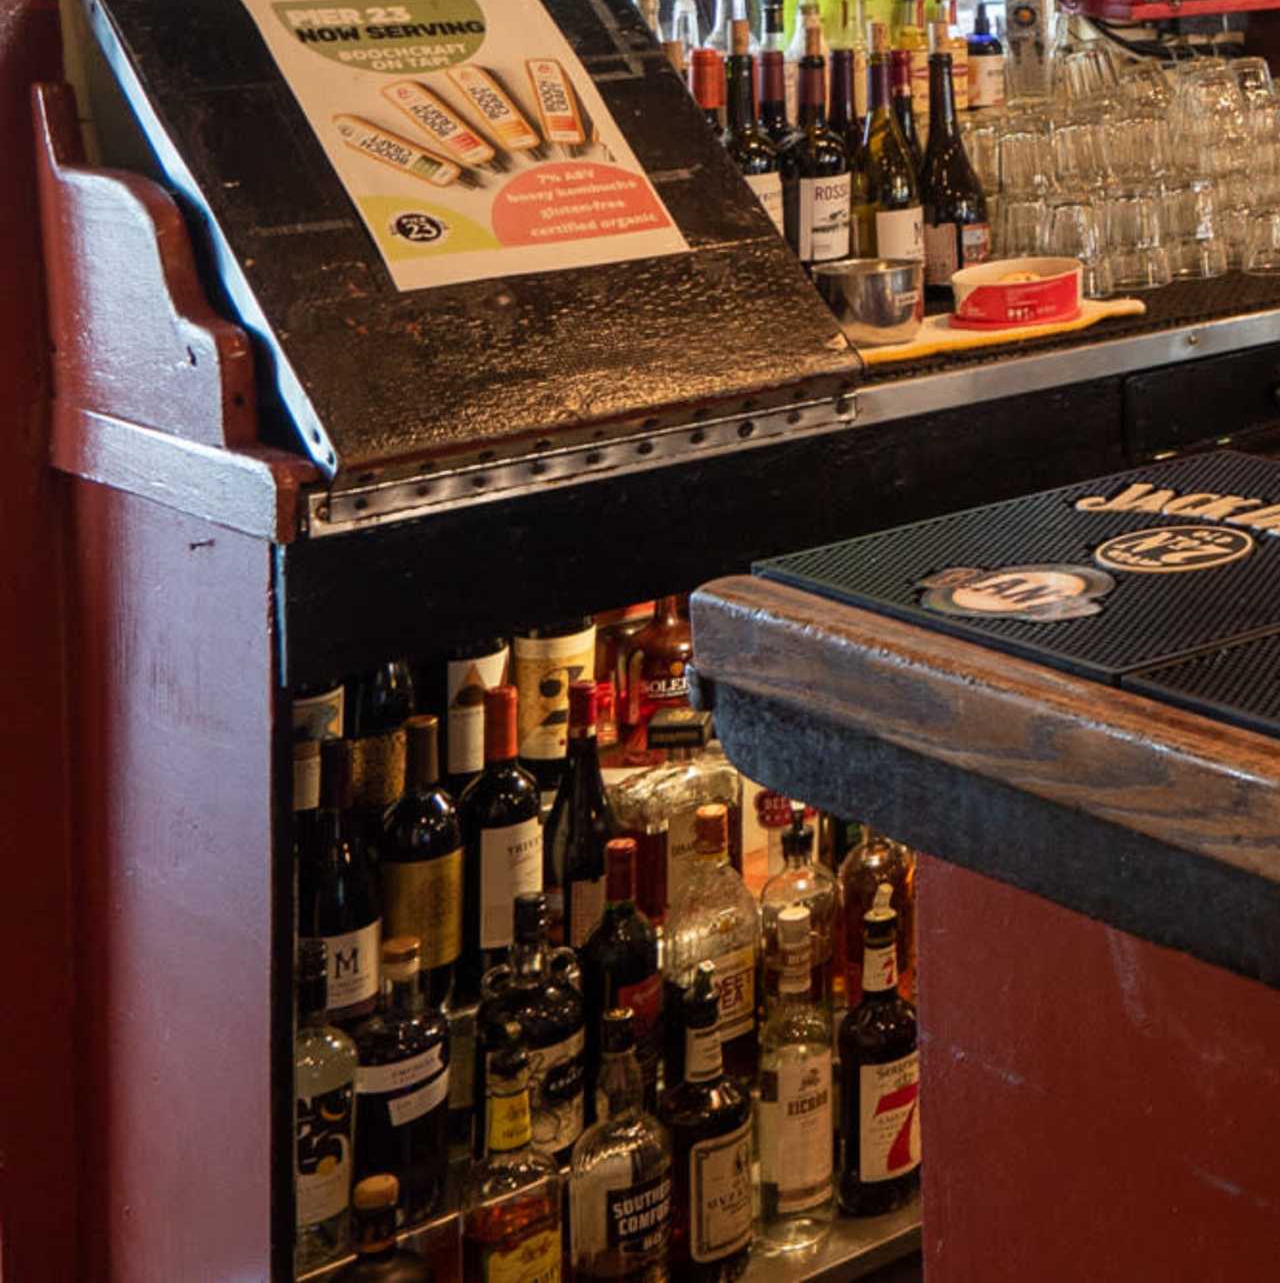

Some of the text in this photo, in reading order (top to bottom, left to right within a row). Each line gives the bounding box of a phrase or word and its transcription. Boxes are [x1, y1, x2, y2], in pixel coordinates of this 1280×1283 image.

[286, 6, 412, 27] PIER 23
[295, 20, 485, 43] NOW SERVING
[337, 43, 467, 62] BOOCHCRAFT
[372, 59, 404, 71] ON
[406, 222, 438, 239] 23
[529, 213, 659, 238] certified organic
[1074, 482, 1264, 523] JACK
[873, 1080, 920, 1172] 7
